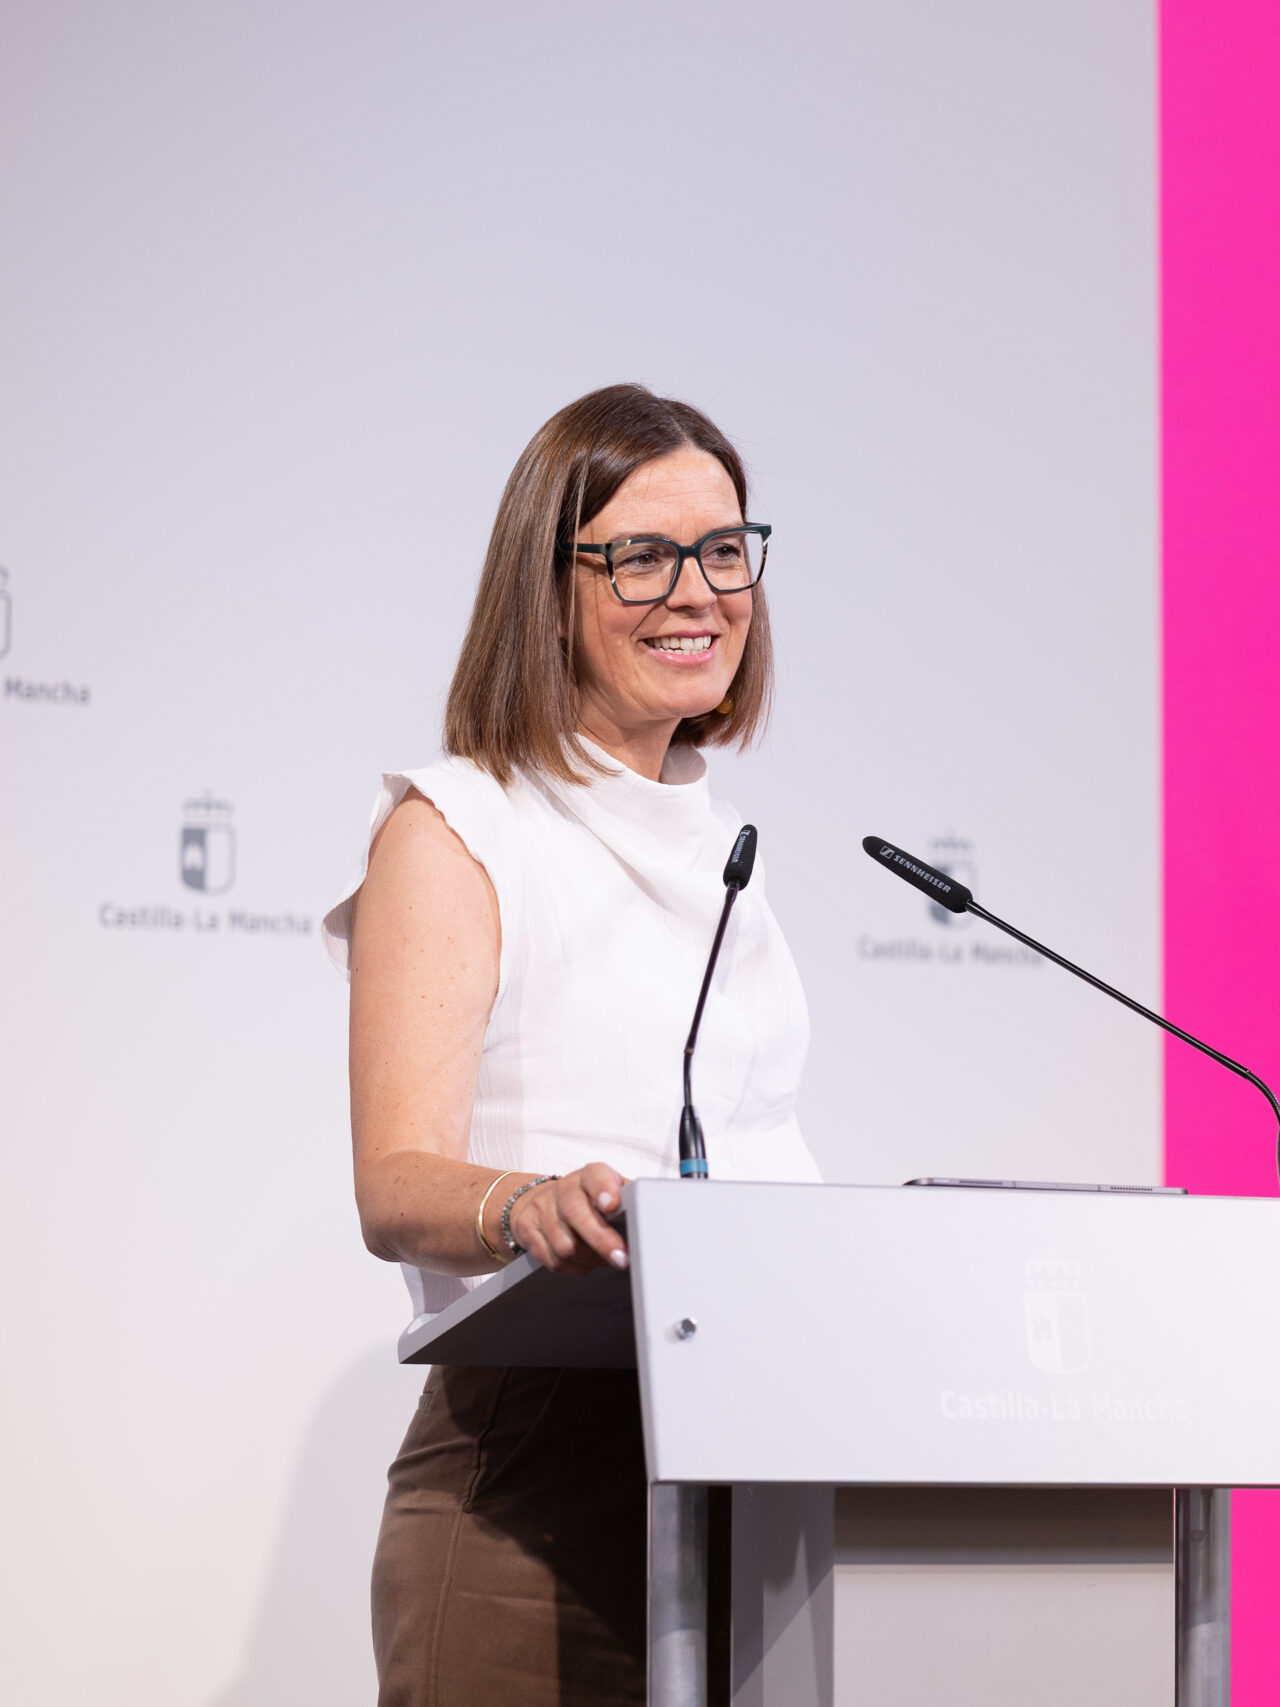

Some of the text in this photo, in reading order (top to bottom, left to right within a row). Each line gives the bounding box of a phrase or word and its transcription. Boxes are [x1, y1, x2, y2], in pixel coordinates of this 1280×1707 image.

[4, 674, 91, 706] Mancha
[893, 854, 952, 893] SENNHEISER
[228, 908, 313, 937] Mancha
[1090, 1391, 1187, 1423] Mancha
